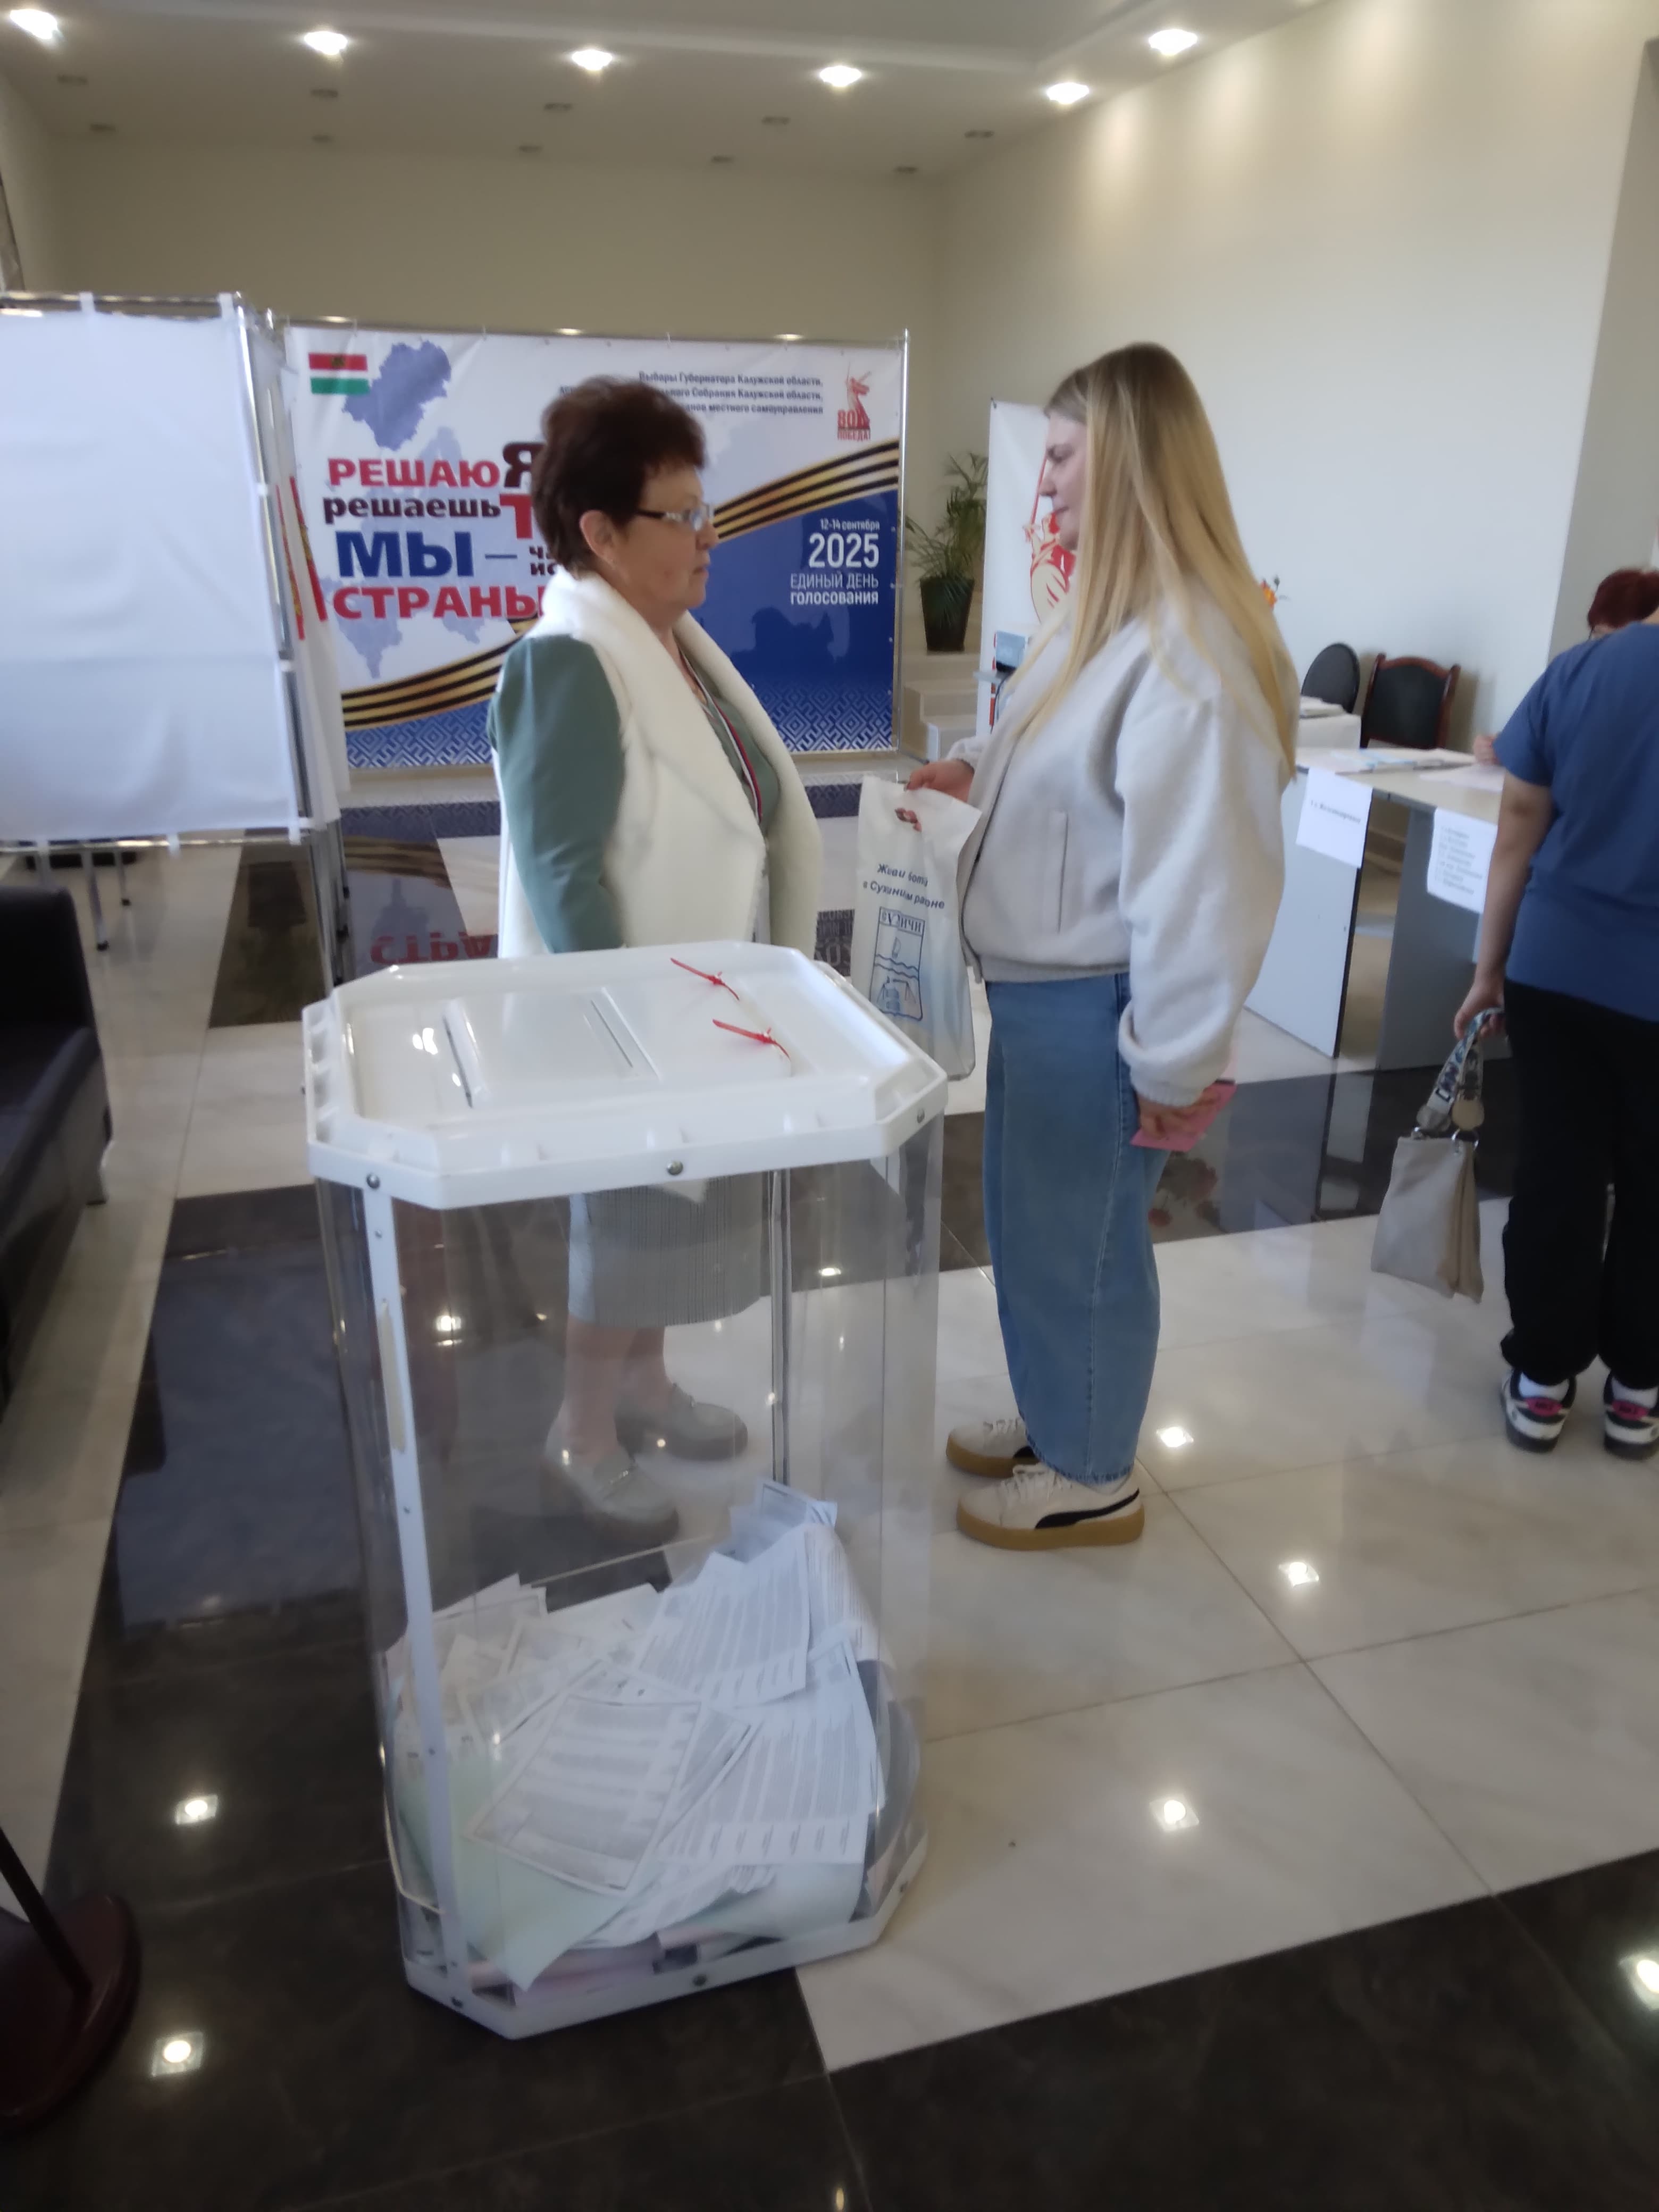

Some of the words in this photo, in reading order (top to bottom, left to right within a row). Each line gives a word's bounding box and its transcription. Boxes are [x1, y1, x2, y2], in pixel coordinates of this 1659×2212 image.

[680, 372, 735, 384] Губернатора
[738, 374, 784, 386] Калужской
[692, 387, 735, 399] Собрания
[738, 389, 784, 399] Калужской
[709, 404, 749, 413] местного
[751, 404, 823, 415] самоуправления
[328, 458, 500, 487] РЕШАЮ
[323, 496, 501, 524] решаешь
[820, 518, 841, 530] 12-14
[842, 519, 880, 531] сентября
[335, 531, 474, 577] МЫ
[809, 533, 879, 568] 2025
[791, 570, 843, 590] ЕДИНЫЙ
[847, 573, 878, 590] ДЕНЬ
